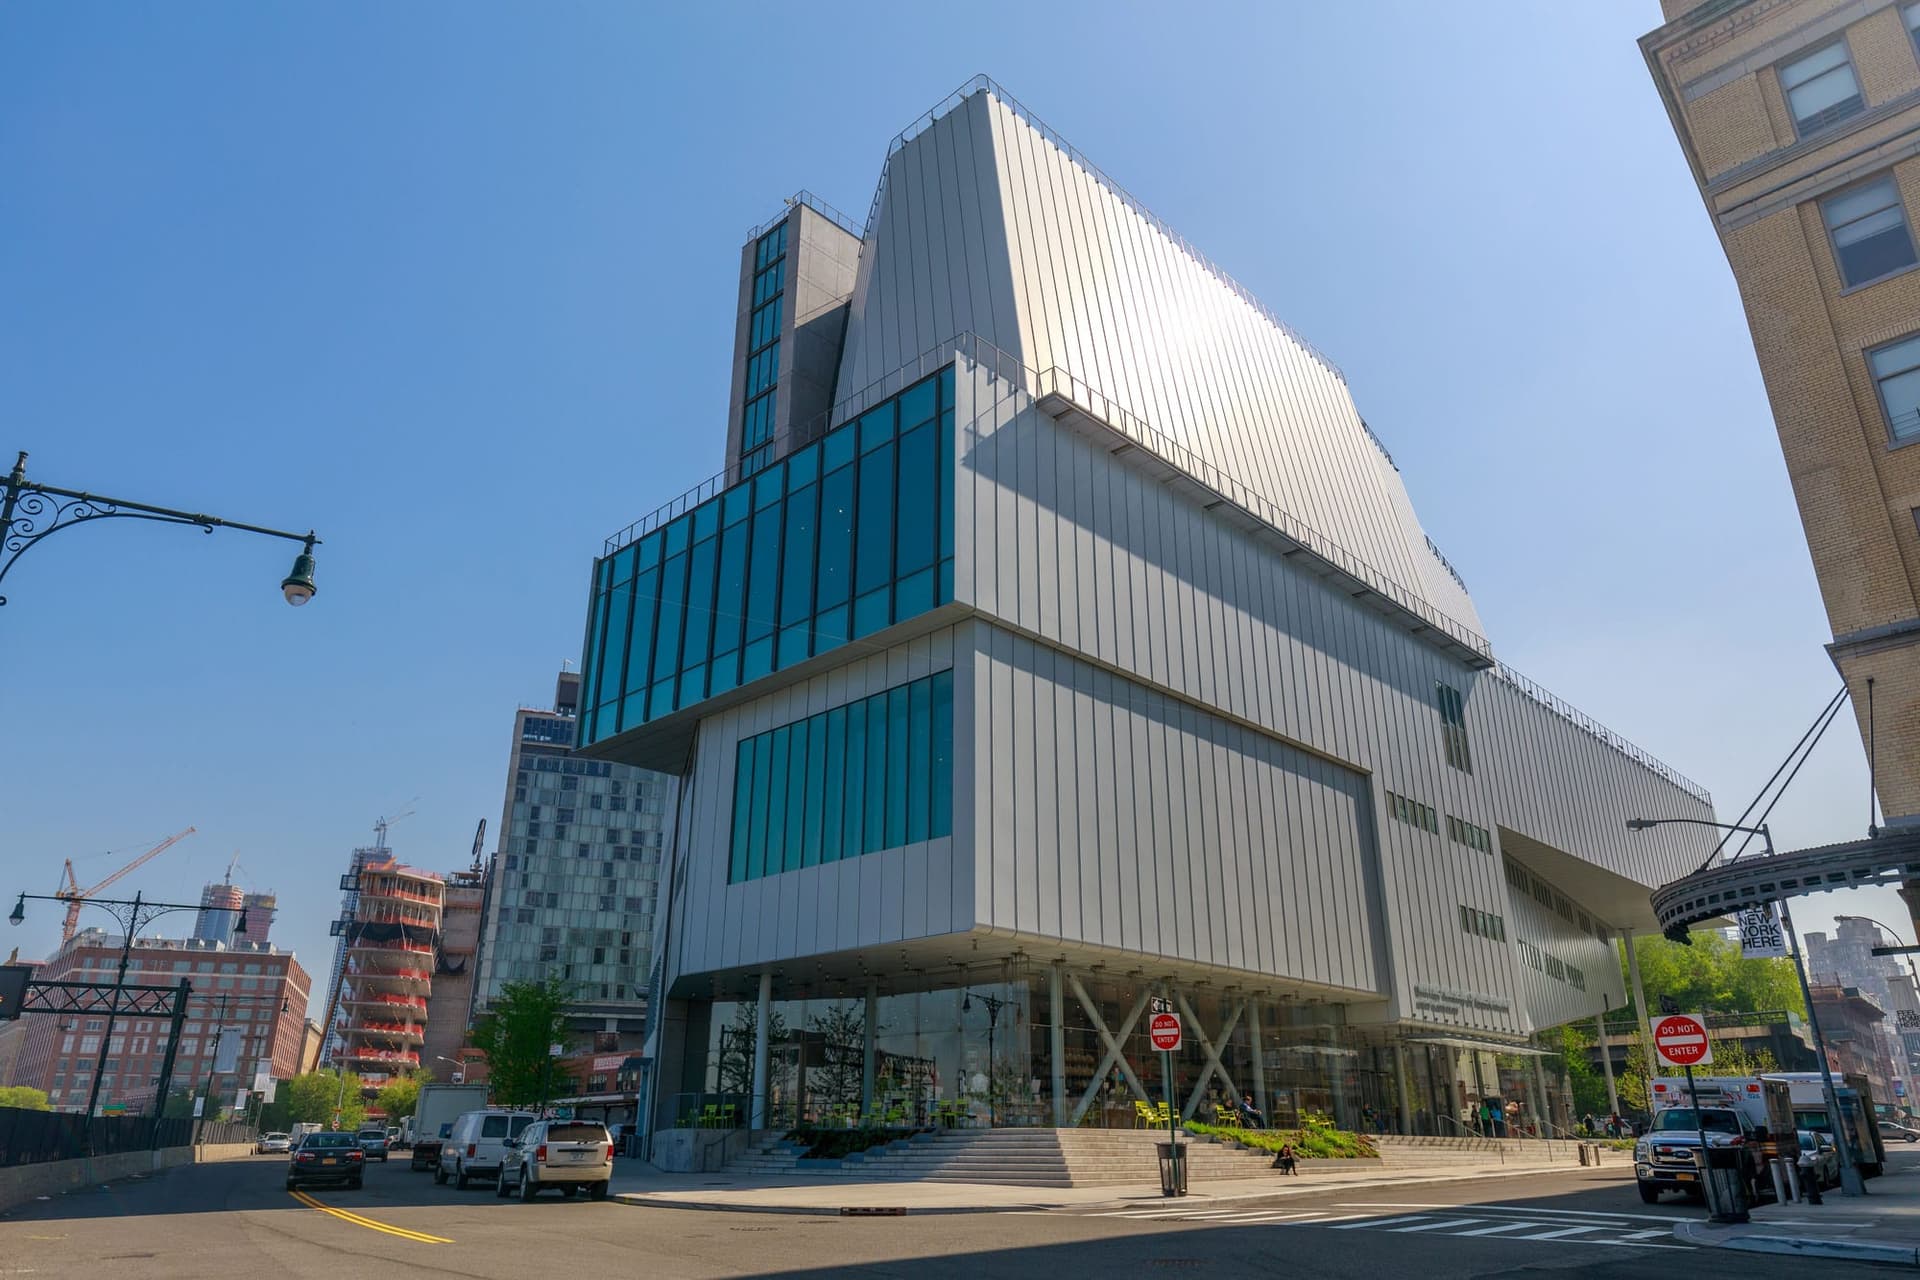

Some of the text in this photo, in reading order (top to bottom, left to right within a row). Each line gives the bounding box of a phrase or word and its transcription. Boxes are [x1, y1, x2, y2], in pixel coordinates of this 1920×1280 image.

[1739, 913, 1770, 926] NEW
[1740, 924, 1780, 937] YORK
[1742, 935, 1782, 949] HERE
[1164, 1020, 1175, 1028] NOT
[1662, 1024, 1695, 1034] DO NOT
[1668, 1046, 1698, 1056] ENTER
